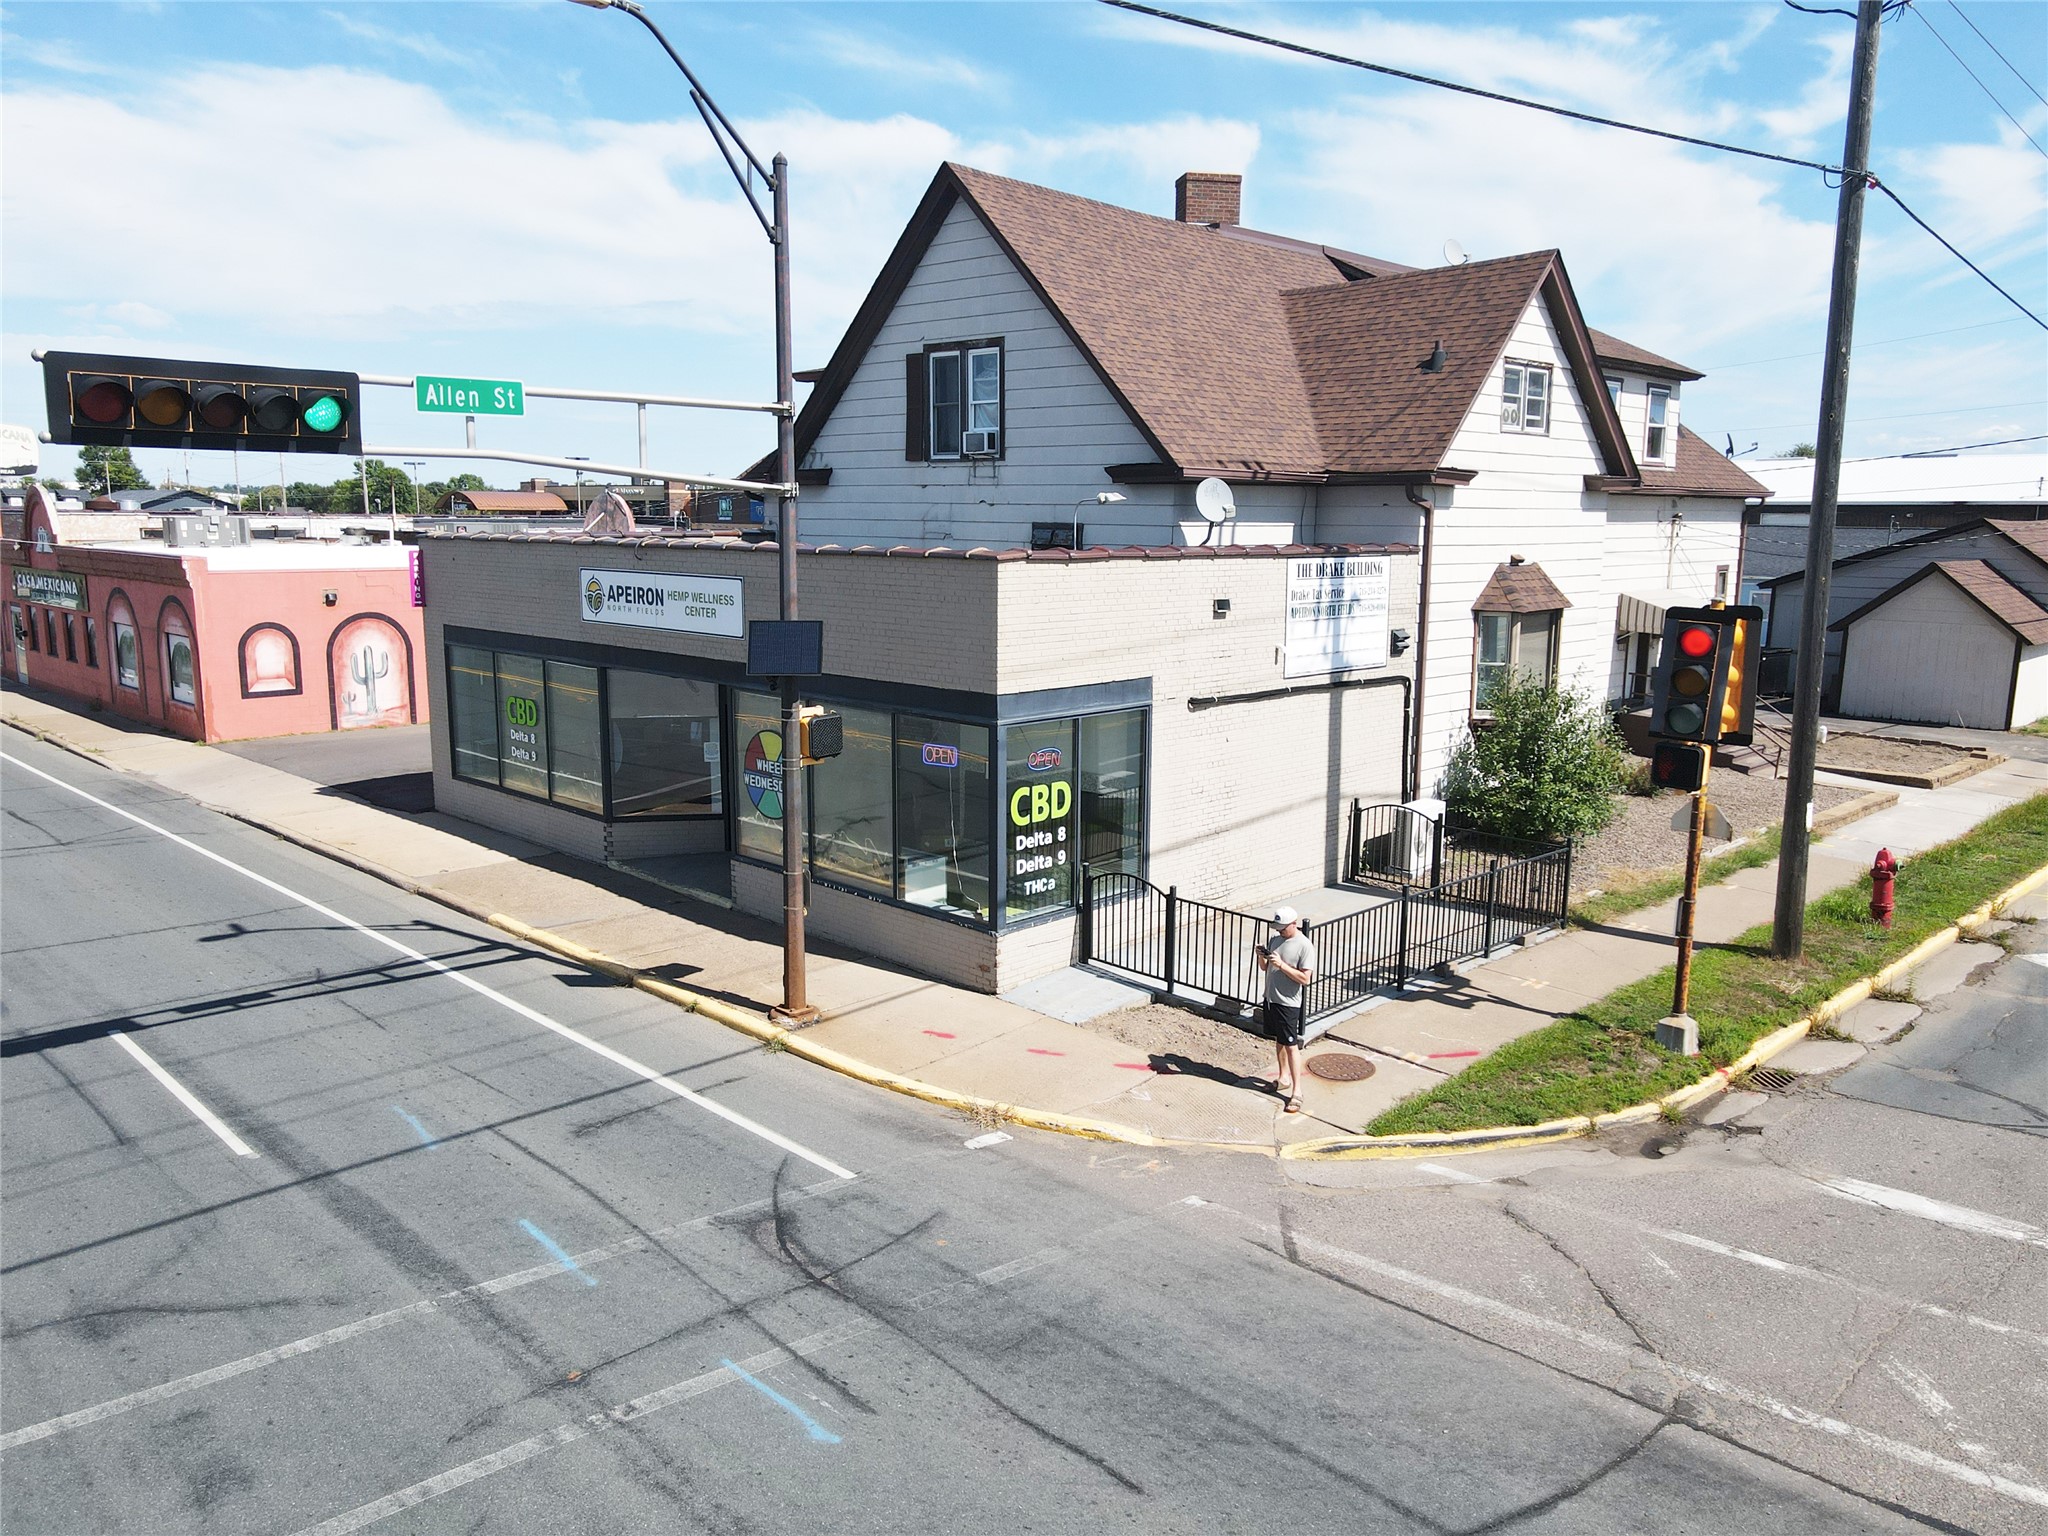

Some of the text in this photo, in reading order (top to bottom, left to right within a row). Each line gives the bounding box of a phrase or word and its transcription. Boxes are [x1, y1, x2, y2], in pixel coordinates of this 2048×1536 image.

[425, 384, 516, 409] Allen St
[1296, 561, 1382, 578] THE DRAKE BUILDING
[17, 574, 35, 589] CASA
[36, 576, 78, 595] MEXICANA
[607, 584, 734, 606] APEIRON HEMP WELLNESS
[1291, 589, 1309, 601] Drake
[1312, 588, 1322, 600] Tax
[1324, 588, 1345, 599] Service
[607, 605, 664, 616] NORTH FIELDS
[684, 606, 717, 618] CENTER
[1291, 606, 1316, 619] APEIRON
[506, 696, 537, 726] CBD
[510, 728, 536, 744] Delta 8
[511, 746, 536, 762] Delta 9
[924, 746, 955, 764] OPEN
[1028, 752, 1062, 766] OPEN
[1010, 780, 1072, 826] CBD
[1016, 826, 1066, 851] Delta 8
[1016, 850, 1066, 875] Delta 9
